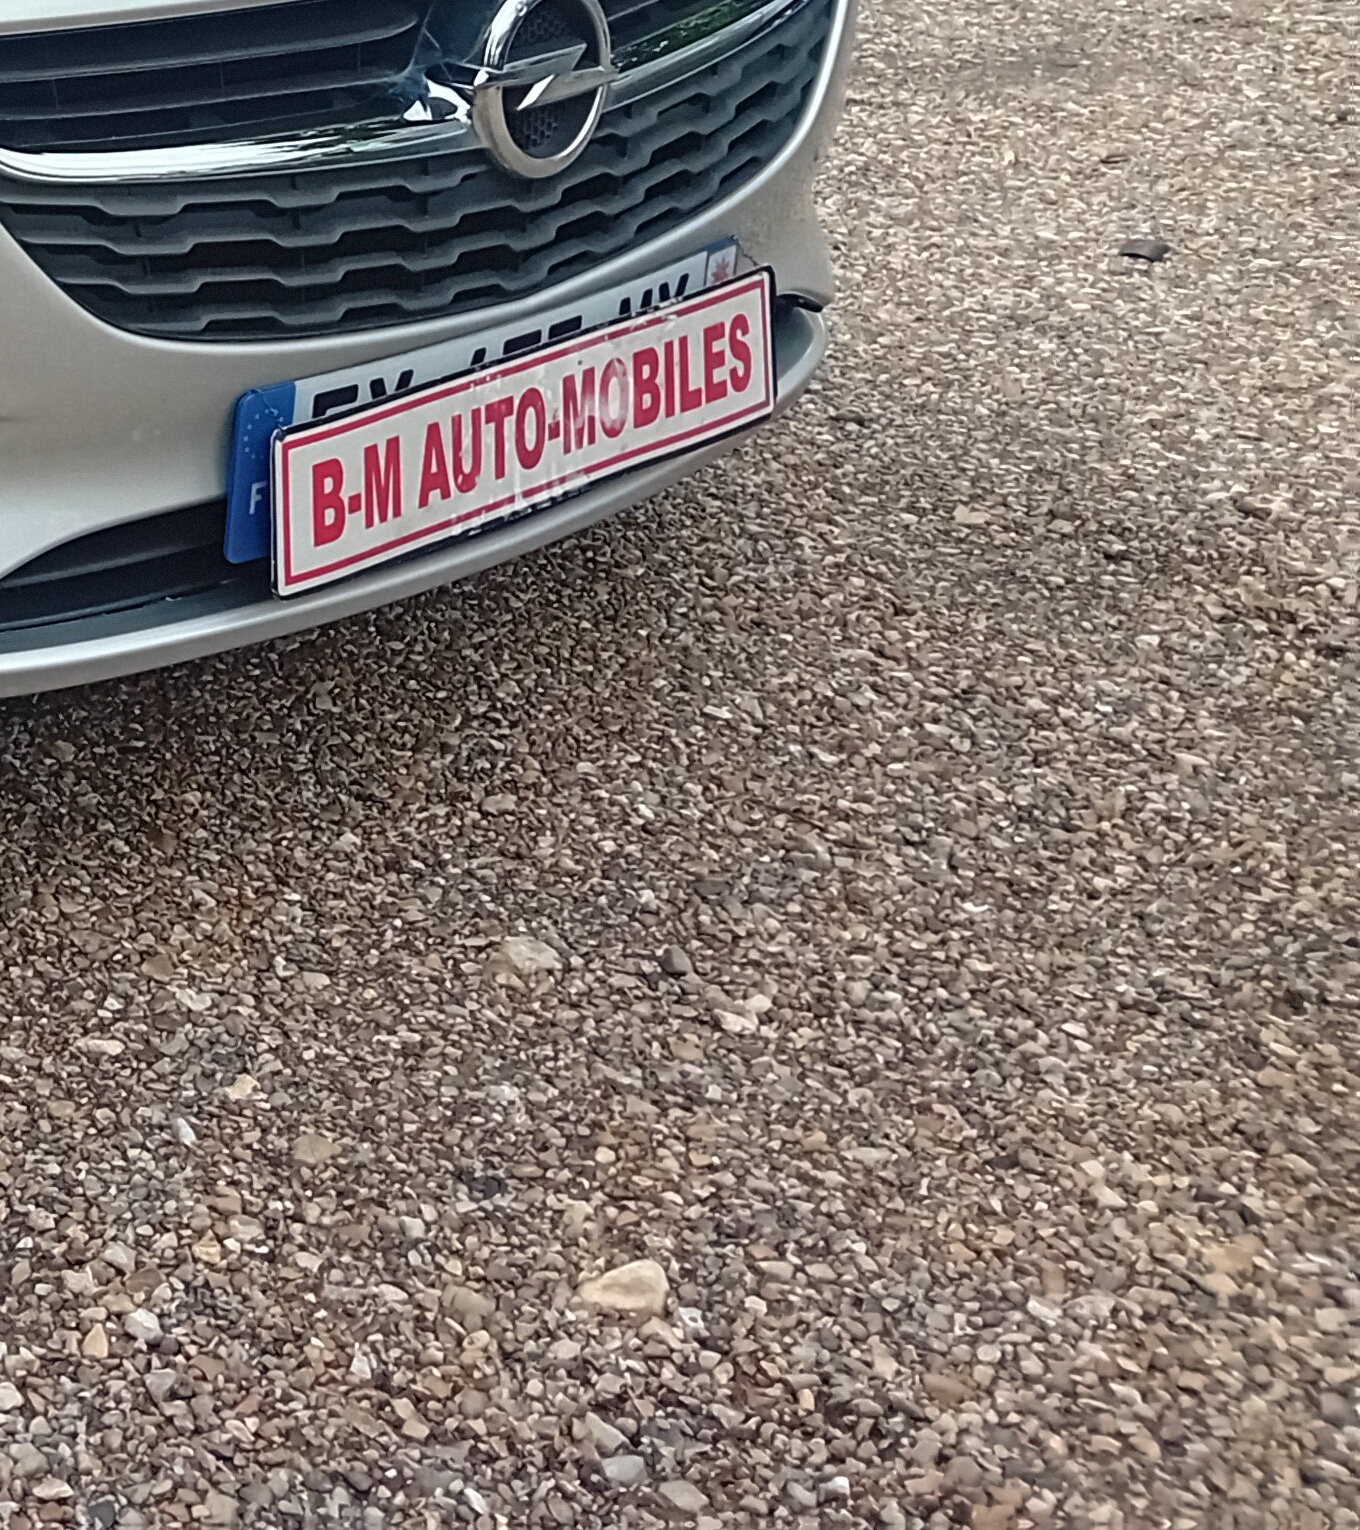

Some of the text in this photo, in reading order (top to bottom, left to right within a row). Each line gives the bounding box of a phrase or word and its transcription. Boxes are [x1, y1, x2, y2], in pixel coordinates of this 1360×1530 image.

[312, 312, 753, 548] B-M AUTO-MOBILES
[249, 481, 266, 515] F
